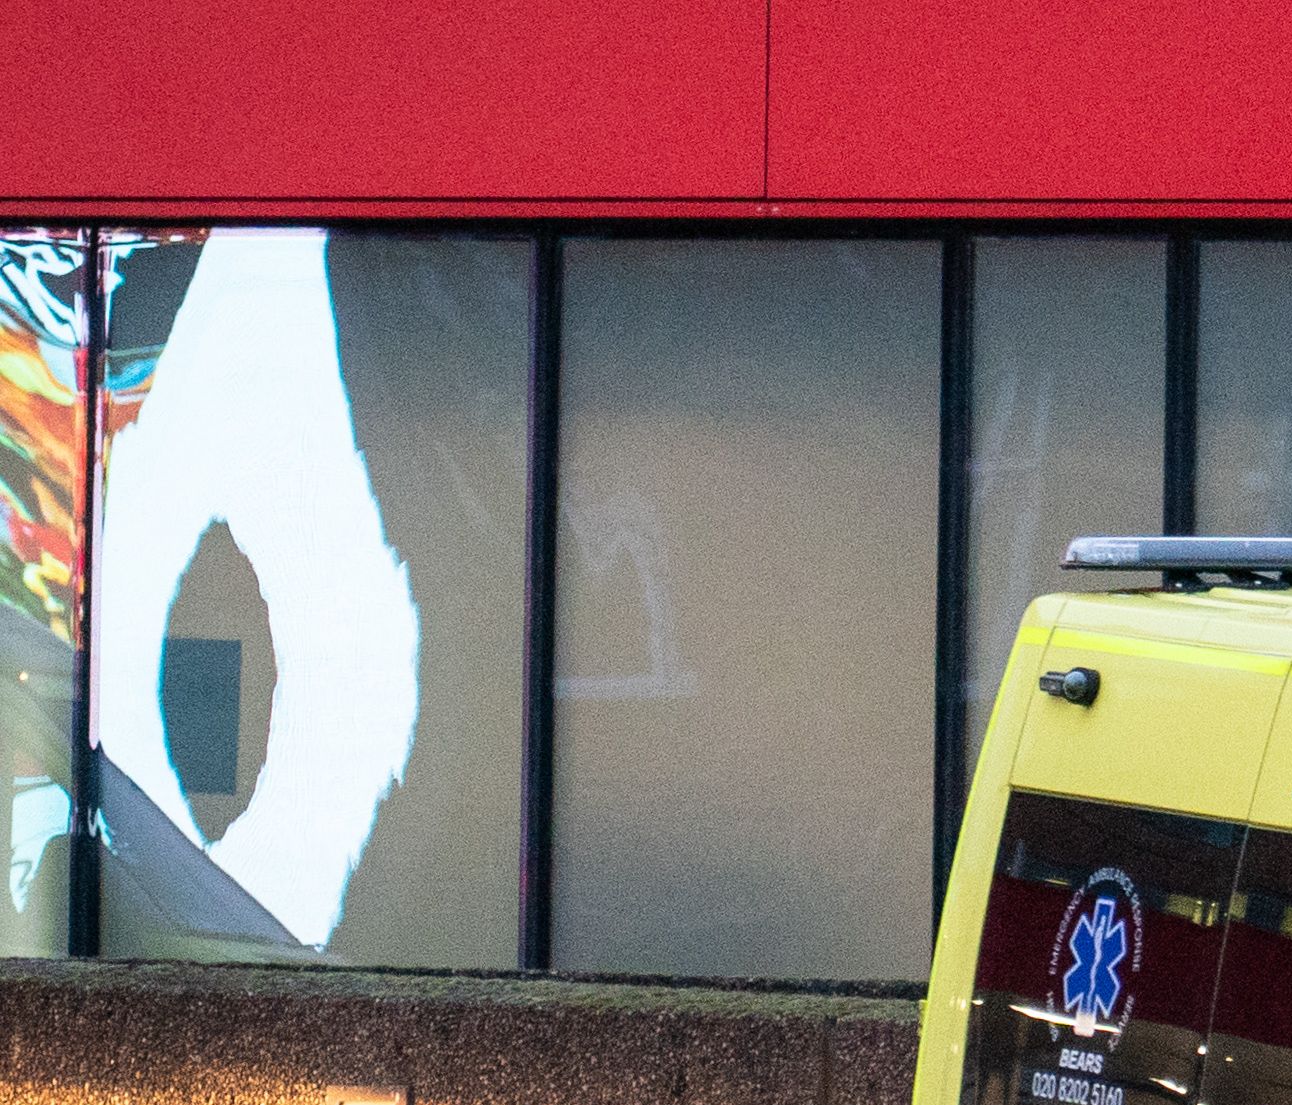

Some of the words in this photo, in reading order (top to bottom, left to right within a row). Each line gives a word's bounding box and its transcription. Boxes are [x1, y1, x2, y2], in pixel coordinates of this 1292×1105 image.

[1059, 1048, 1104, 1074] BEARS
[1032, 1071, 1056, 1099] 020
[1058, 1076, 1090, 1105] 8202
